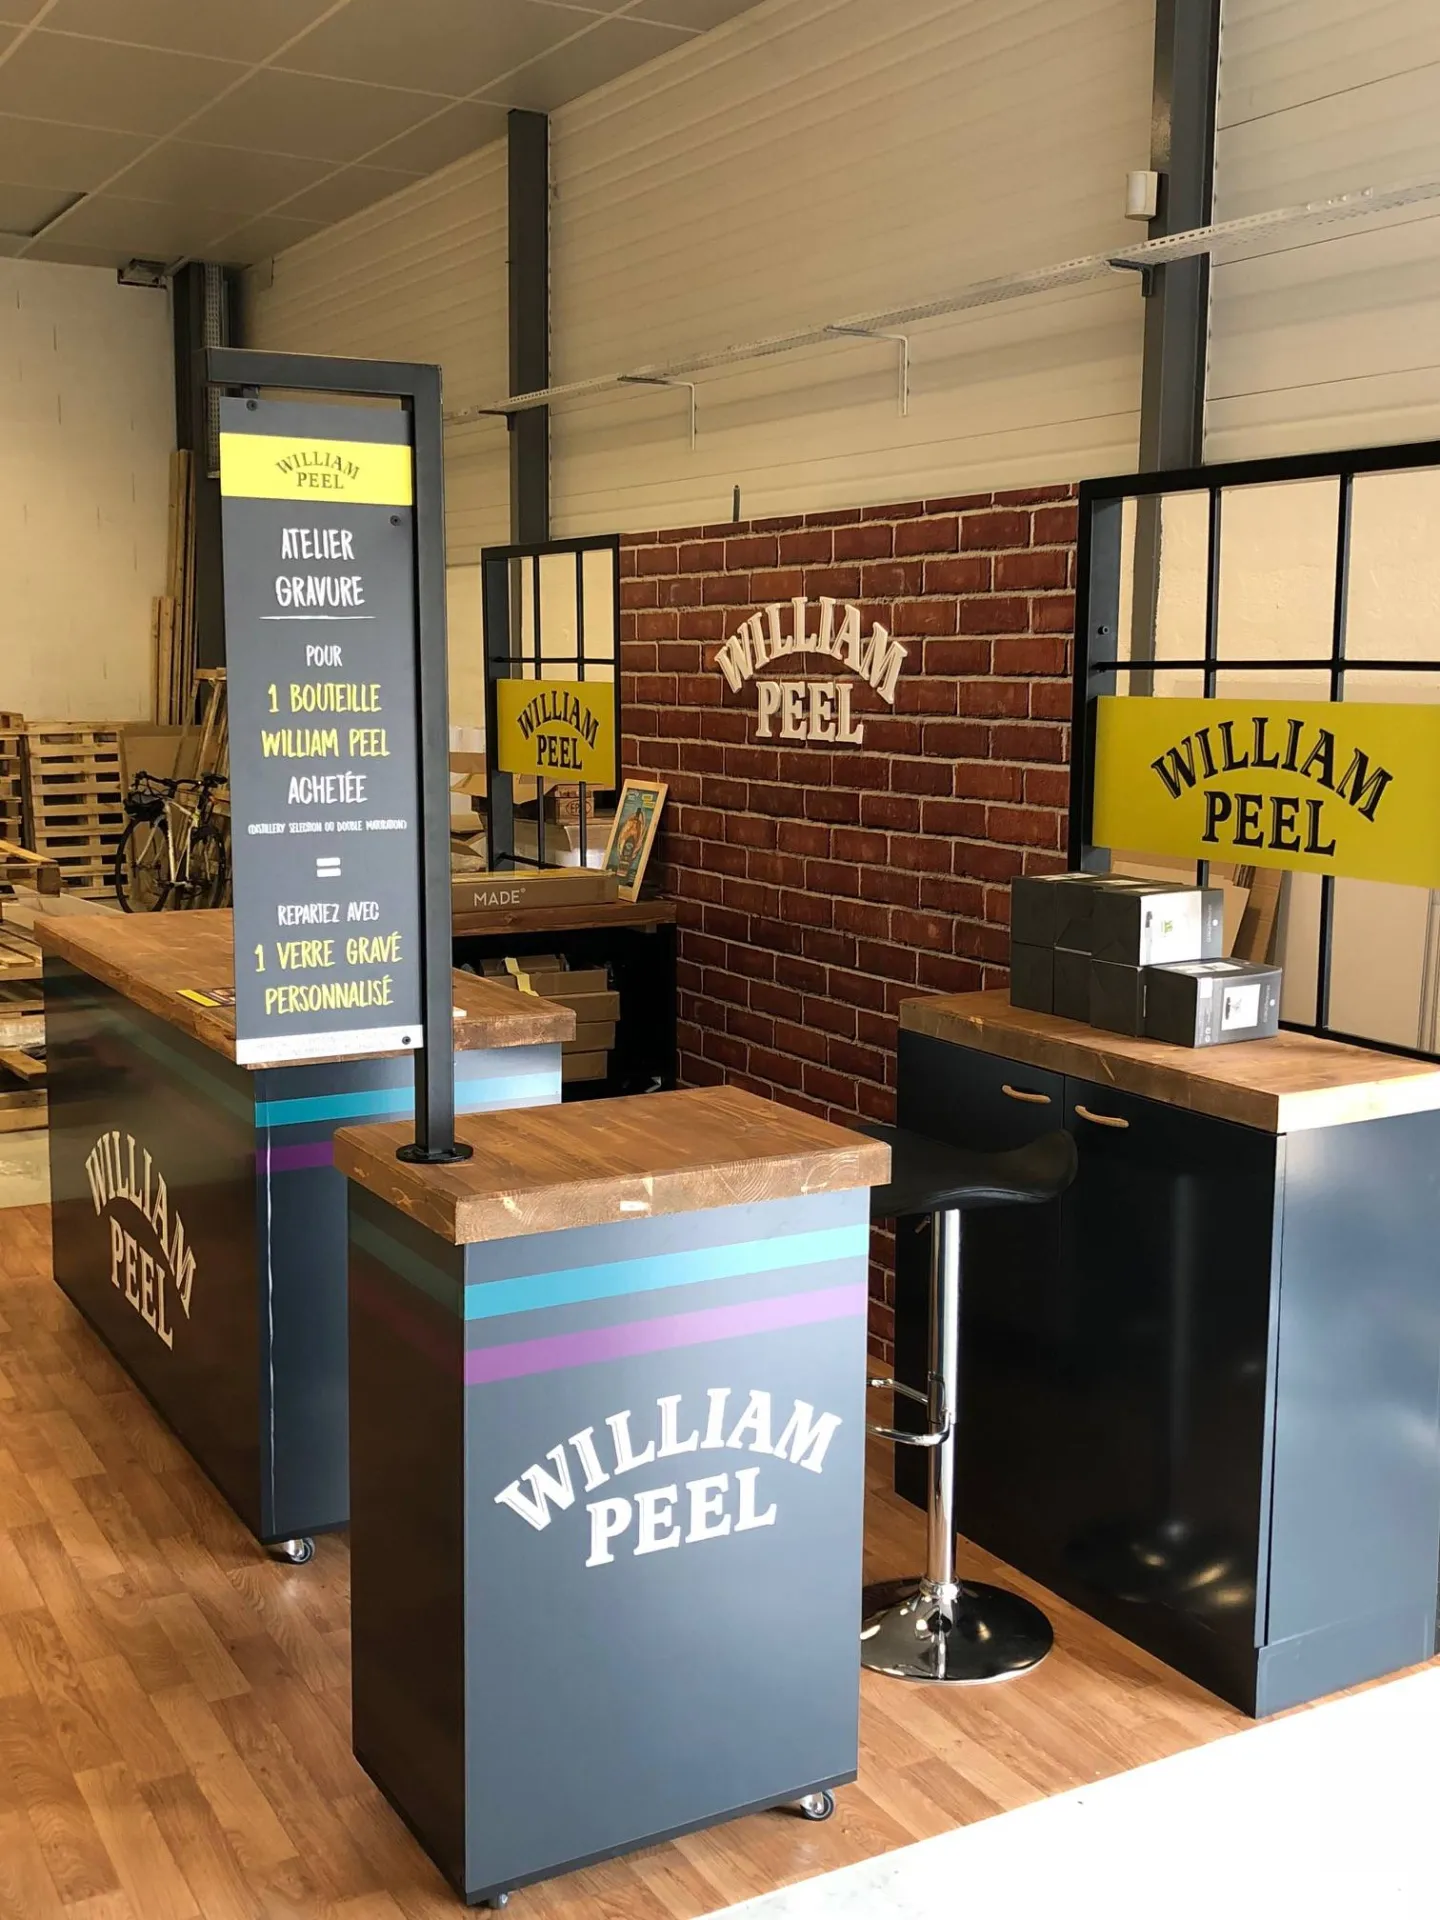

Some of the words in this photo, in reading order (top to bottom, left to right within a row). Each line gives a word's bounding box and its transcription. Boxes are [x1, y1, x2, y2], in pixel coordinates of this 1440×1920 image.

[275, 451, 360, 480] WILLIAM
[296, 471, 344, 490] PEEL
[281, 528, 355, 560] ATELIER
[275, 575, 365, 607] GRAVURE
[306, 644, 342, 667] POUR
[714, 596, 908, 704] WILLIAM
[268, 684, 279, 713] 1
[290, 682, 382, 713] BOUTEILLE
[755, 681, 864, 744] PEEL
[516, 690, 599, 749] WILLIAM
[261, 728, 339, 758] WILLIAM
[349, 727, 391, 757] PEEL
[536, 734, 582, 770] PEEL
[287, 770, 368, 804] ACHETÉE
[1150, 716, 1393, 823] WILLIAM
[1201, 790, 1336, 856] PEEL
[277, 903, 340, 926] REPARTEZ
[347, 901, 379, 922] AVEC
[254, 944, 265, 973] 1
[277, 939, 336, 971] VERRE
[346, 931, 403, 966] GRAVÉ
[264, 975, 395, 1016] PERSONNALISÉ
[85, 1130, 197, 1319] WILLIAM
[110, 1215, 174, 1350] PEEL
[494, 1387, 844, 1532] WILLIAM
[584, 1466, 777, 1568] PEEL
